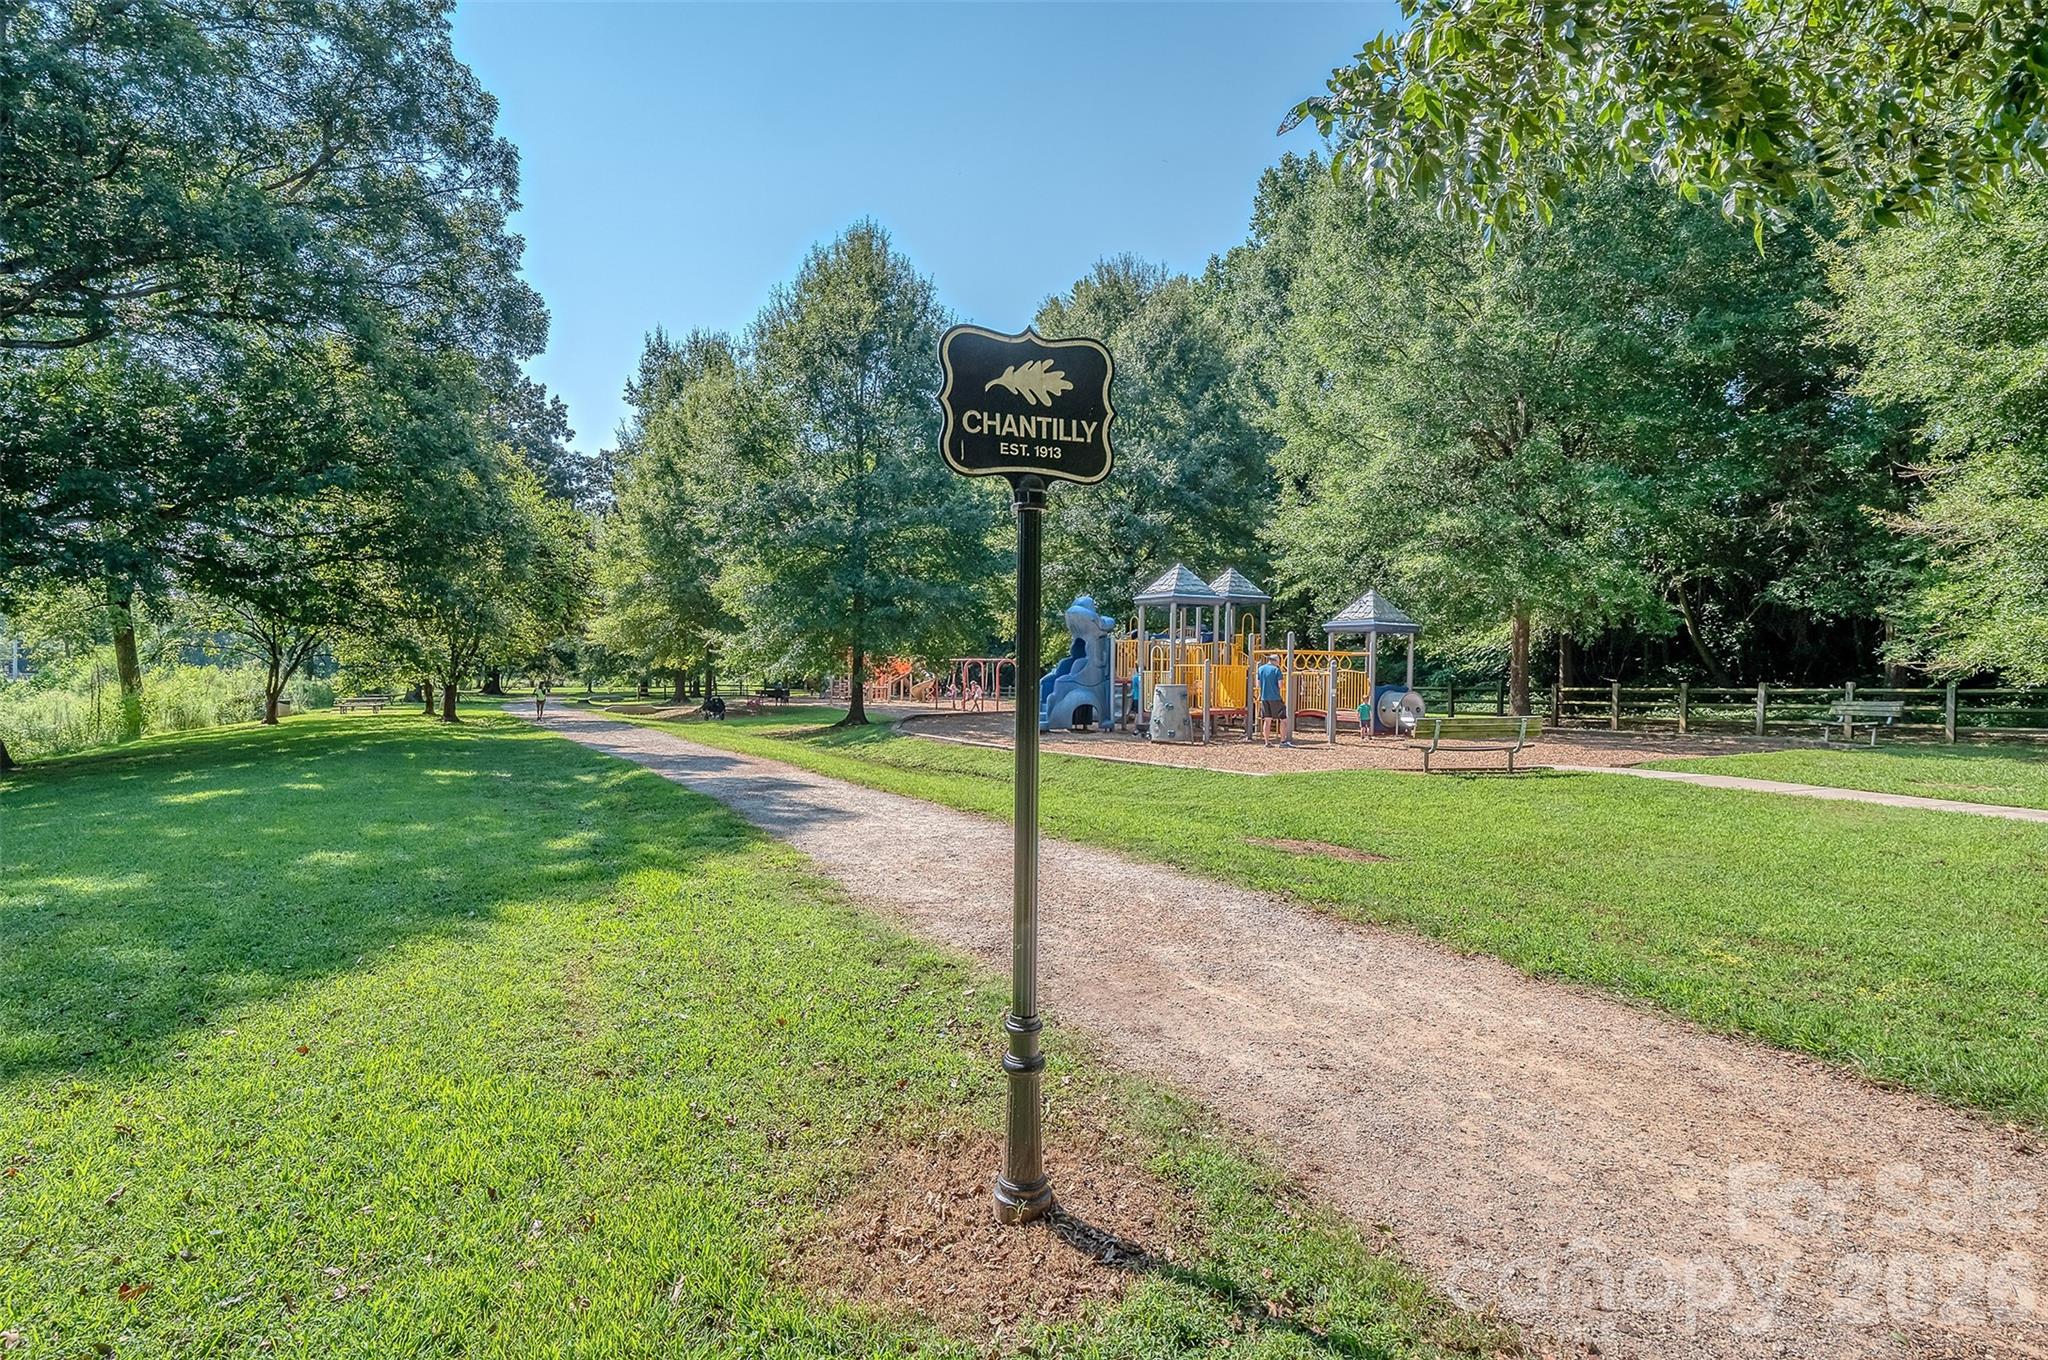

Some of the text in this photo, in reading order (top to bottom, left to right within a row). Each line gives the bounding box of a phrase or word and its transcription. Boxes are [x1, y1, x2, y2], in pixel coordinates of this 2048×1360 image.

[962, 410, 1098, 443] CHANTILLY
[1000, 443, 1062, 459] EST. 1913
